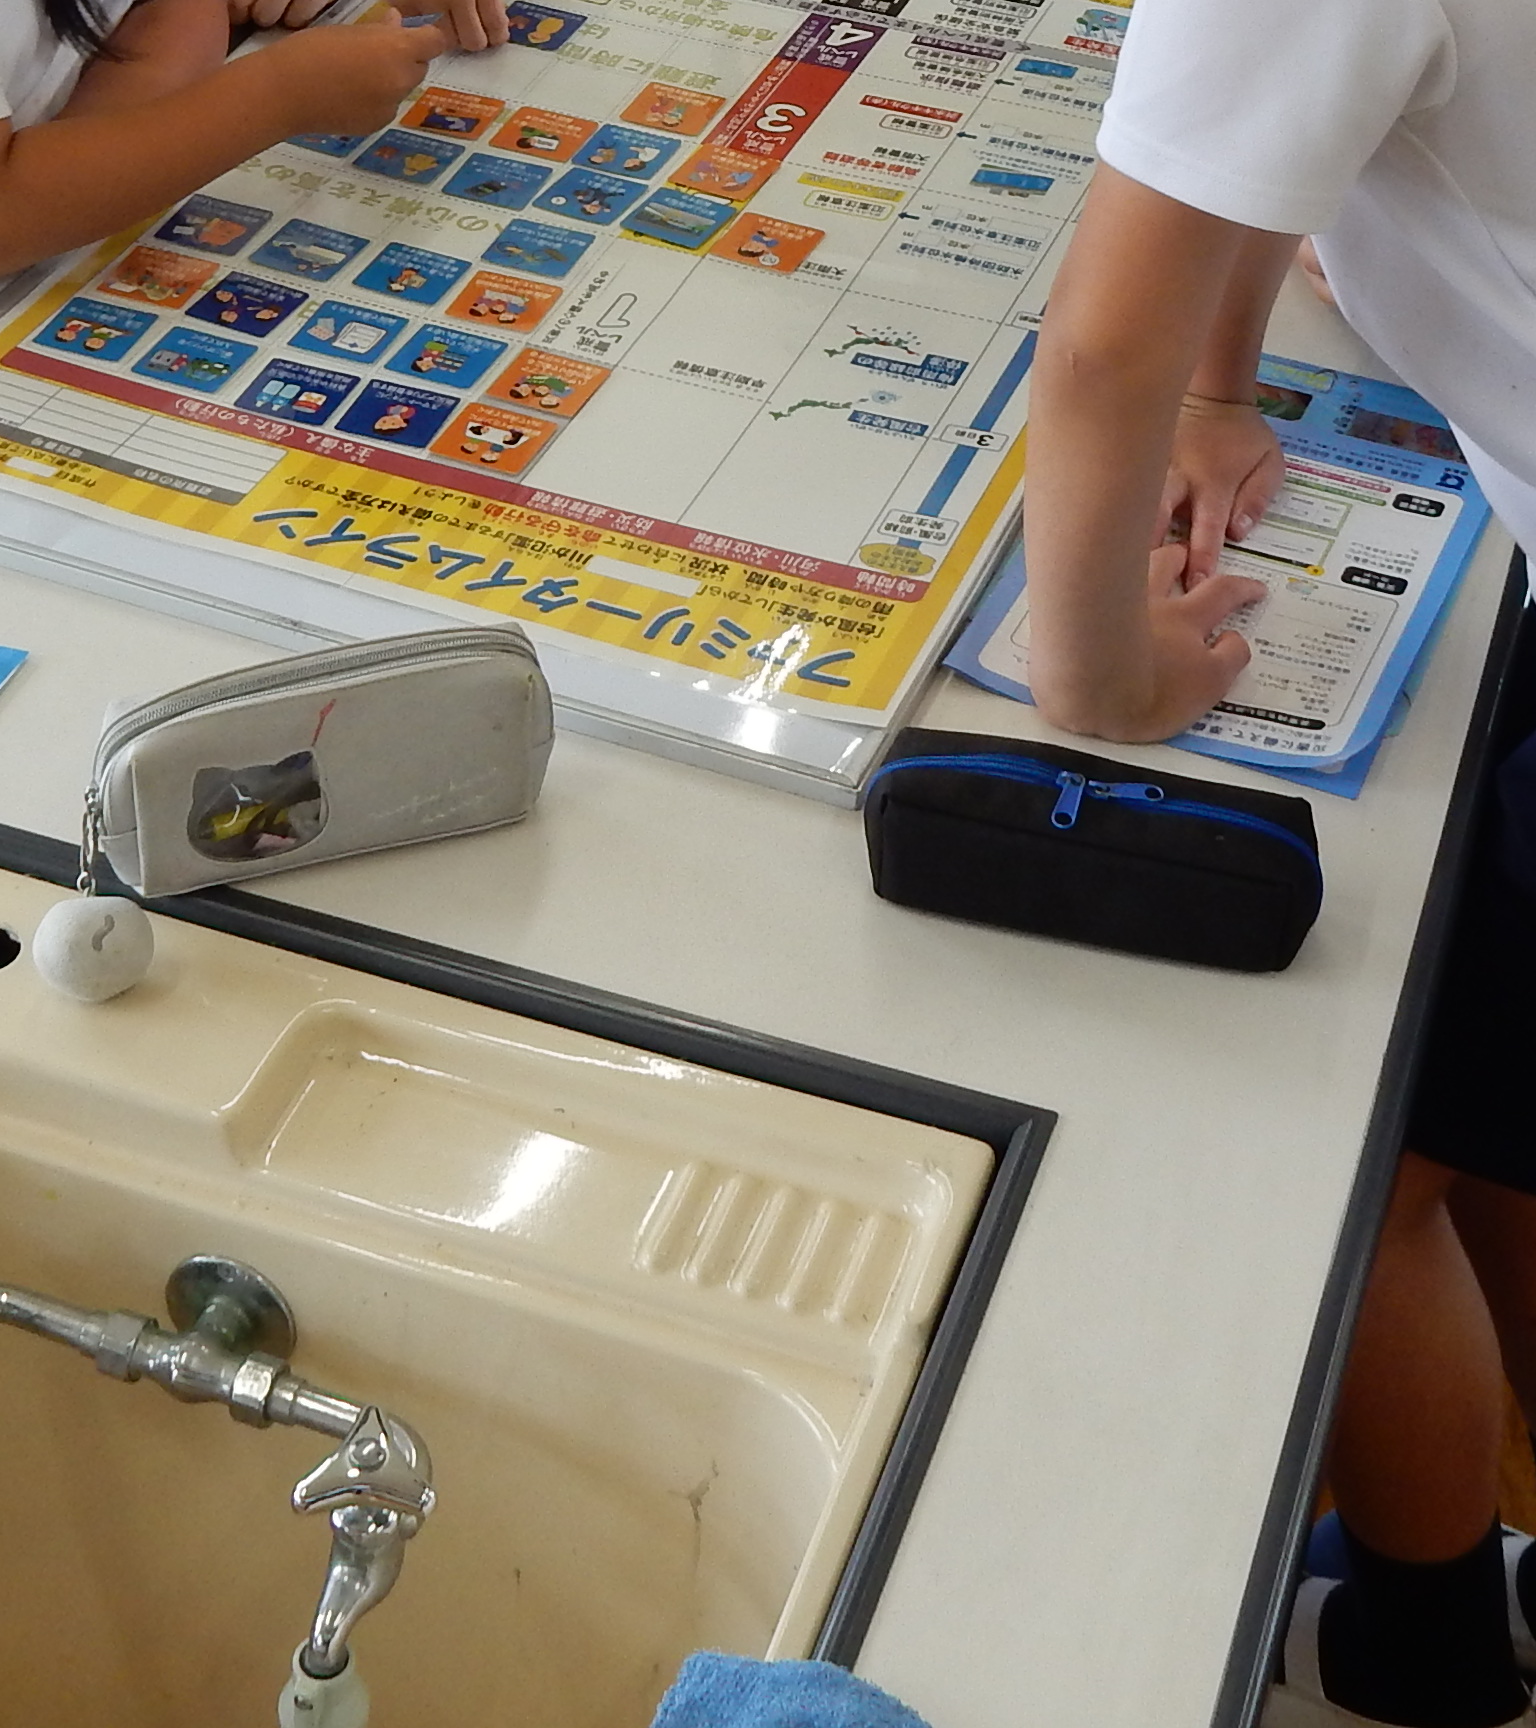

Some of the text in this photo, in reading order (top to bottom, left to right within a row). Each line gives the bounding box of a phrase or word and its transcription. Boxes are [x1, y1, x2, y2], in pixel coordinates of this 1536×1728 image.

[824, 21, 875, 46] 4
[817, 44, 859, 59] レベル
[755, 103, 807, 133] 3
[744, 130, 788, 145] レベル
[821, 151, 920, 177] 高齢者等避難
[595, 292, 638, 329] 1
[576, 324, 623, 344] レベル
[576, 335, 609, 353] 警戒
[671, 360, 767, 390] 早期注意情報
[852, 412, 920, 436] 台風発生
[954, 429, 996, 448] 3日前
[530, 490, 655, 532] 防災・避難情報
[877, 521, 947, 543] 台風・前線
[691, 531, 822, 574] 河川・水位情報
[855, 572, 916, 594] 時間軸
